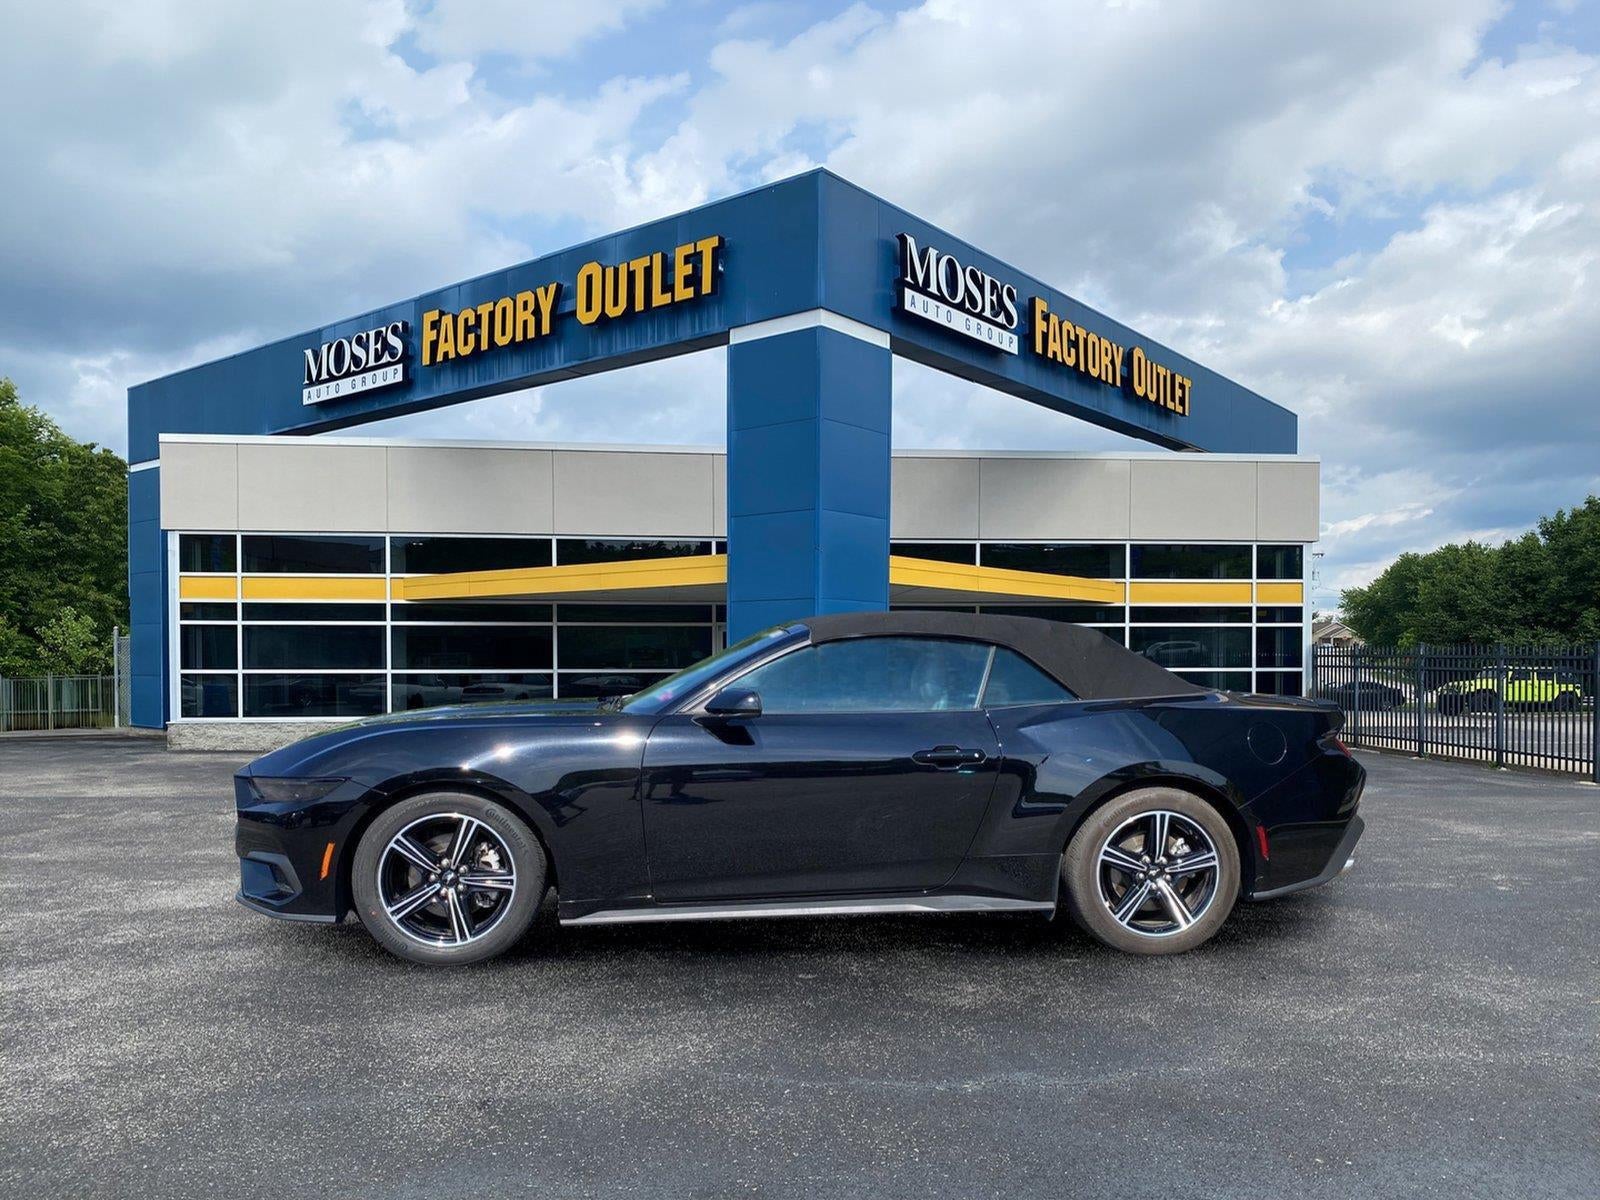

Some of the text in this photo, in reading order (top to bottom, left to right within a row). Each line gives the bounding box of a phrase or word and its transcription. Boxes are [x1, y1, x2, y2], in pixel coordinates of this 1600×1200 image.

[422, 235, 719, 366] FACTORY OUTLET
[903, 233, 1018, 329] MOSES
[910, 294, 1015, 348] AUTO GROUP
[303, 321, 403, 385] MOSES
[307, 368, 399, 401] AUTO GROUP
[1034, 296, 1192, 417] FACTORY OUTLET
